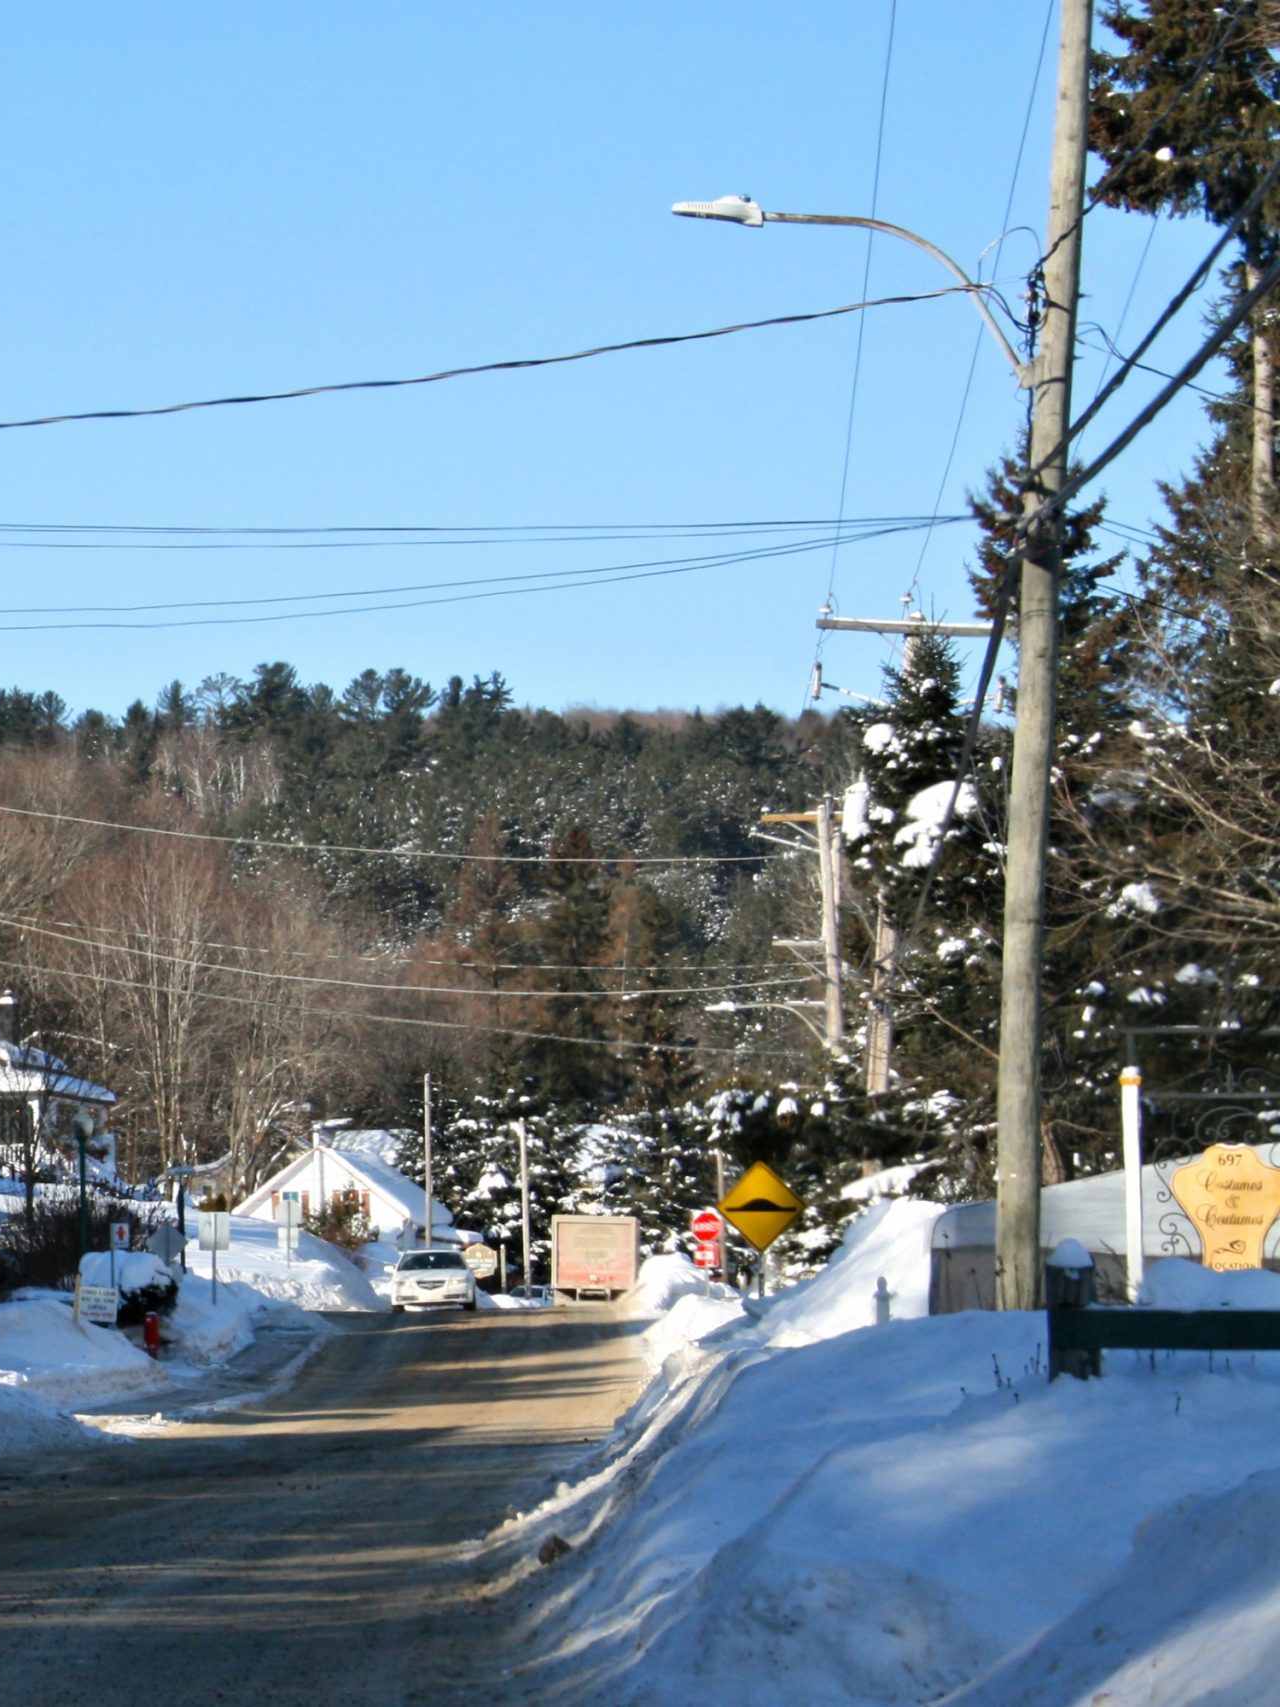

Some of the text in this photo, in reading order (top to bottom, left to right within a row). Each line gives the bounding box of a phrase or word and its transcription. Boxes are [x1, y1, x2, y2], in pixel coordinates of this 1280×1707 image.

[1218, 1154, 1242, 1166] 697
[1196, 1169, 1263, 1192] Costumes
[1226, 1195, 1240, 1208] &
